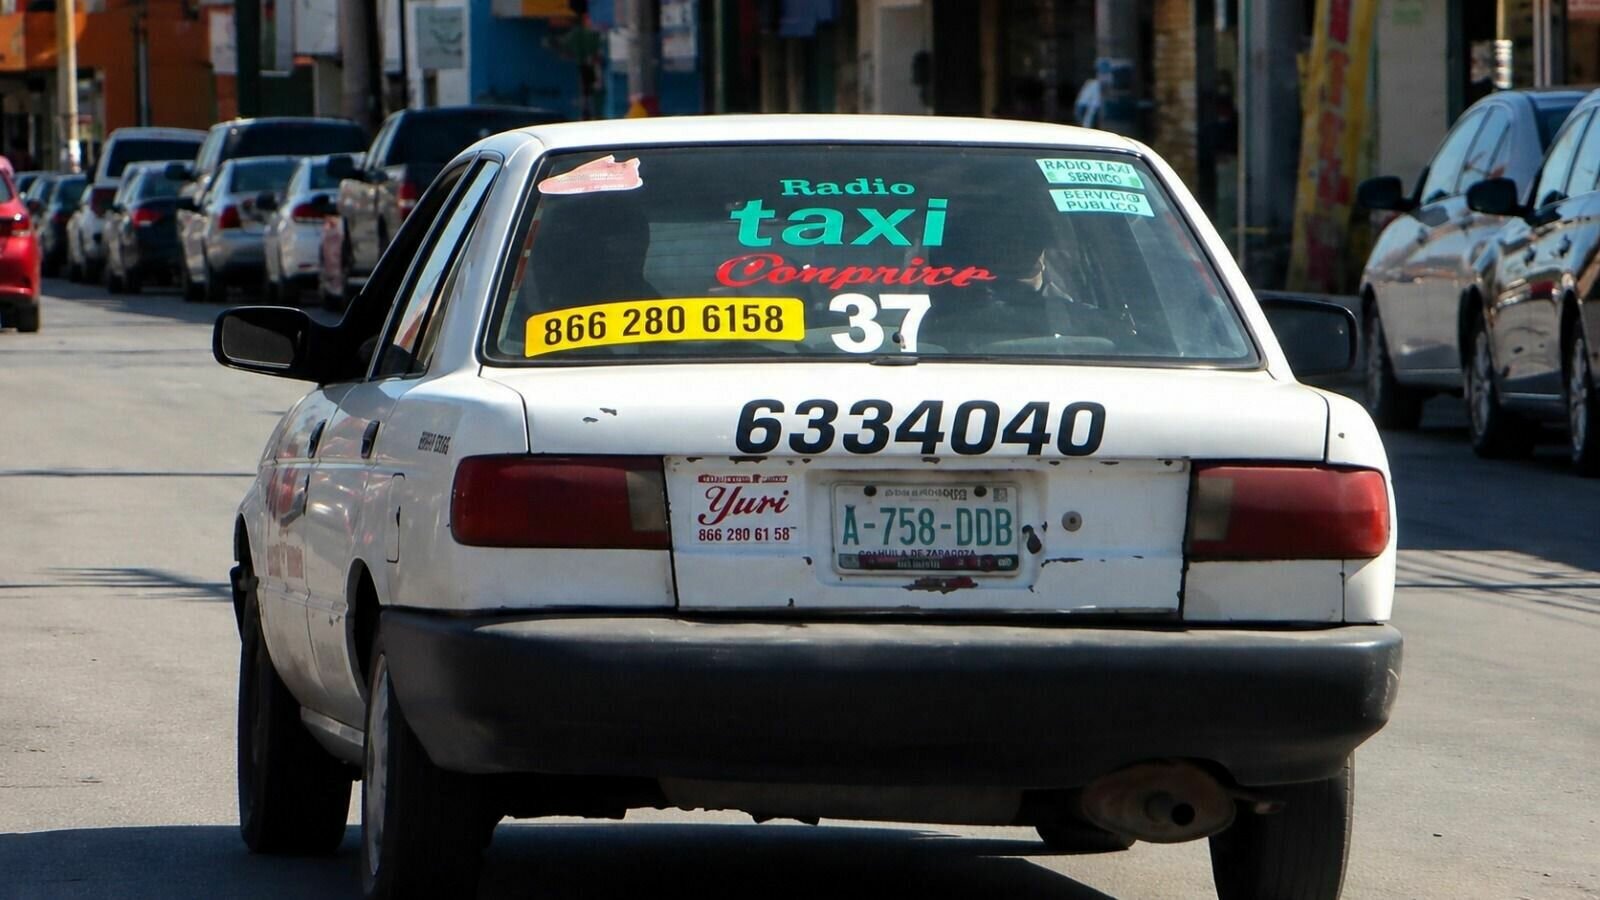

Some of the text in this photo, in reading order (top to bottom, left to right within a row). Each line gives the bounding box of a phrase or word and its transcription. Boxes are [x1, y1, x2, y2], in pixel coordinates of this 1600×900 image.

[780, 178, 915, 195] Radio
[1044, 160, 1130, 174] RADIO TAXI
[730, 198, 948, 246] taxi
[1067, 200, 1138, 213] PUBLICO
[544, 304, 783, 345] 866 280 6158
[829, 293, 932, 353] 37
[735, 399, 1106, 456] 6334040
[698, 486, 790, 526] Yuri
[842, 503, 1012, 546] A-758-DDB
[698, 528, 722, 541] 866
[727, 528, 750, 541] 280
